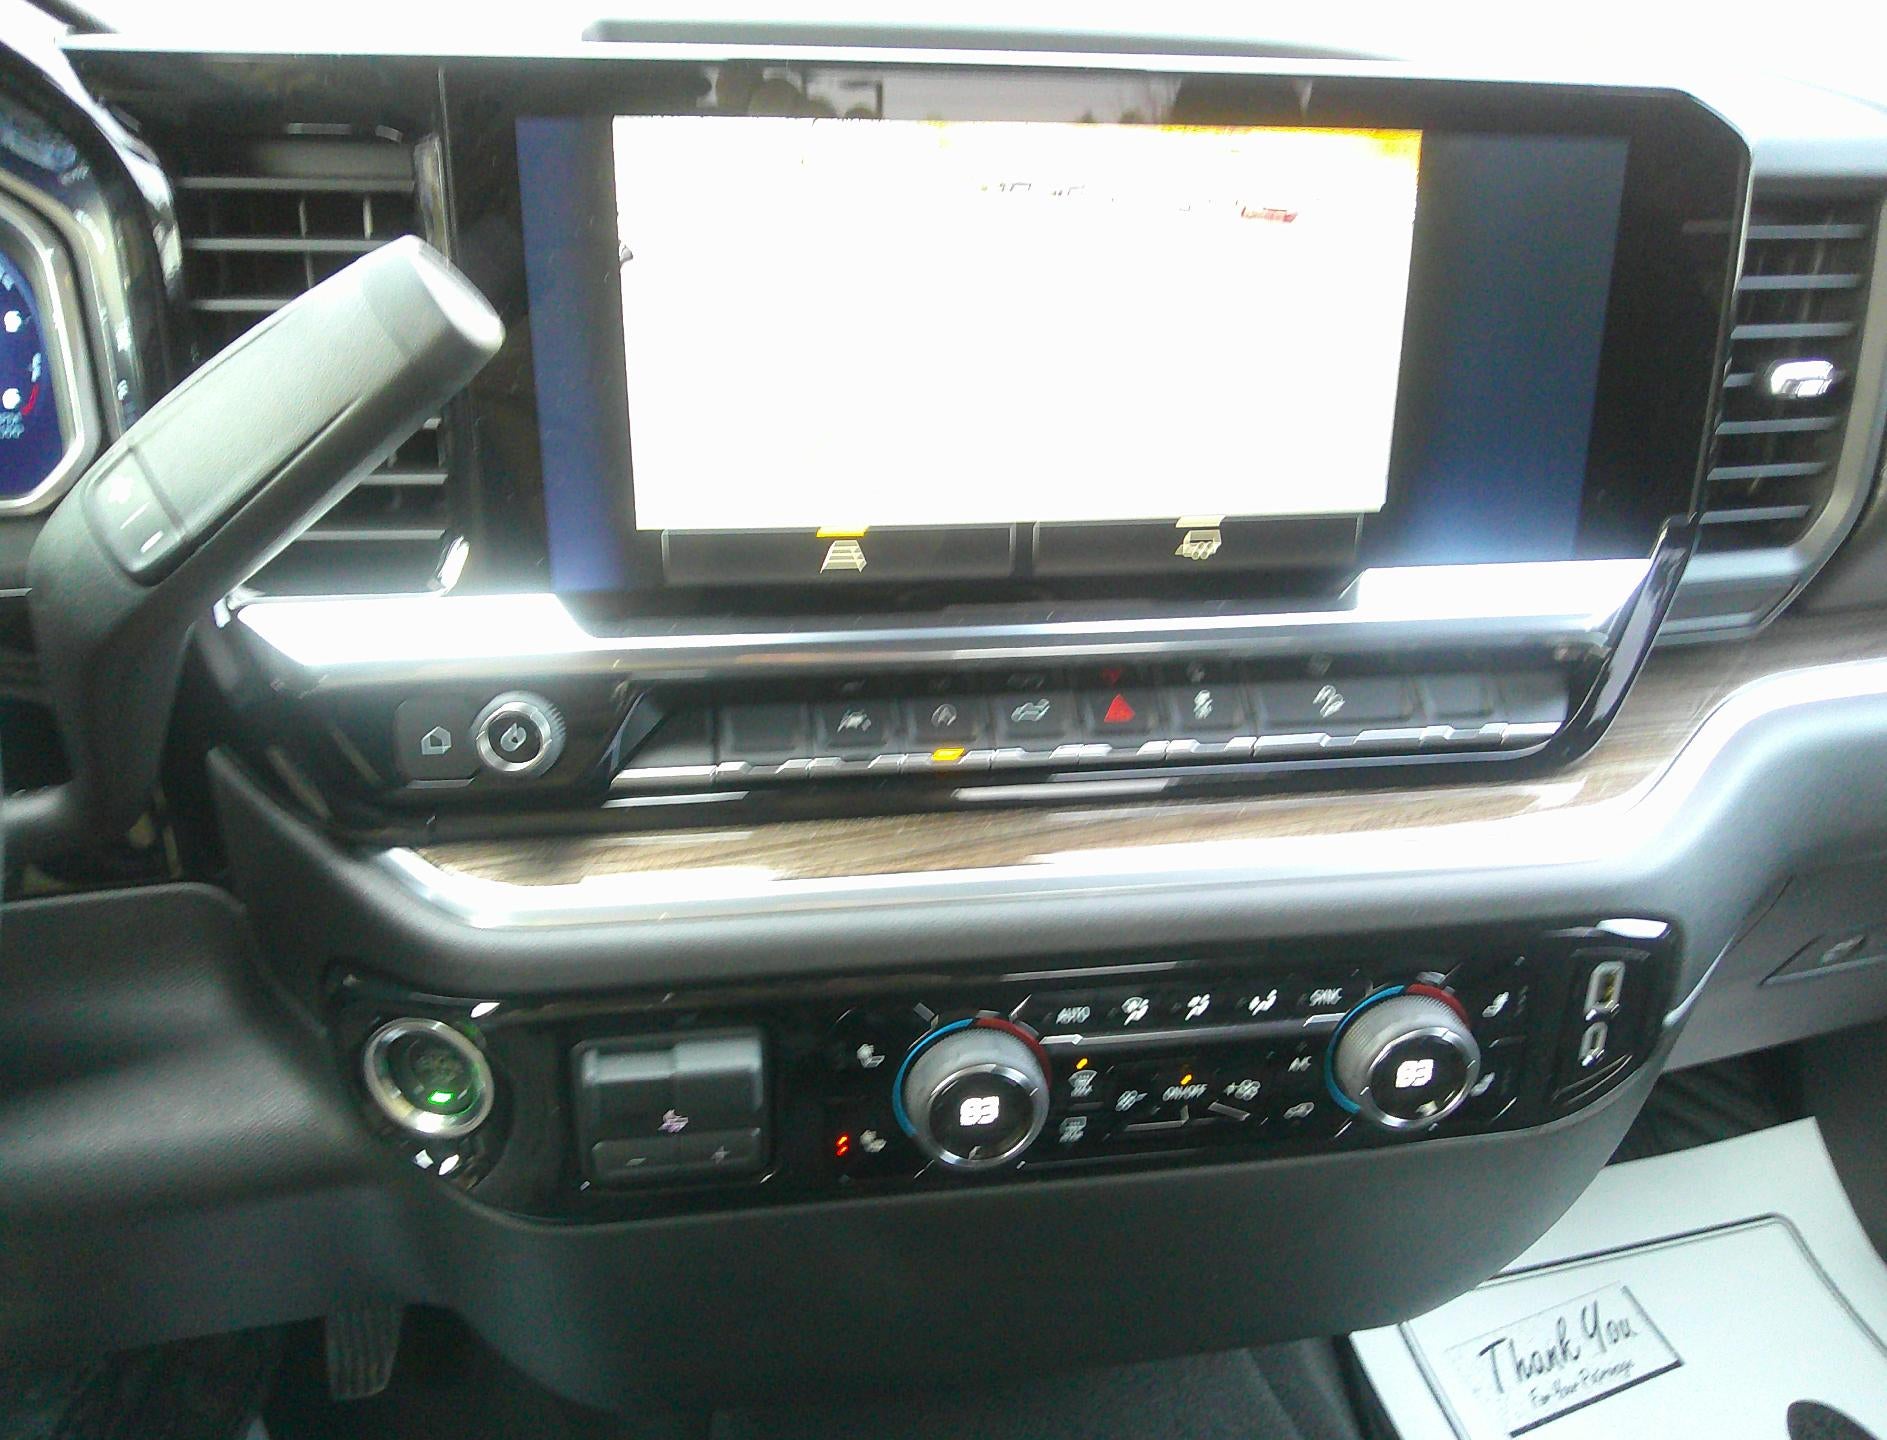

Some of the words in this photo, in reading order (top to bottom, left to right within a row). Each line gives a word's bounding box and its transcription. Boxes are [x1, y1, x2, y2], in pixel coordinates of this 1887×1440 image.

[1310, 987, 1343, 1007] SYNC
[1056, 1006, 1091, 1024] AUTO
[1478, 1316, 1580, 1394] Thank
[1581, 1299, 1638, 1353] You
